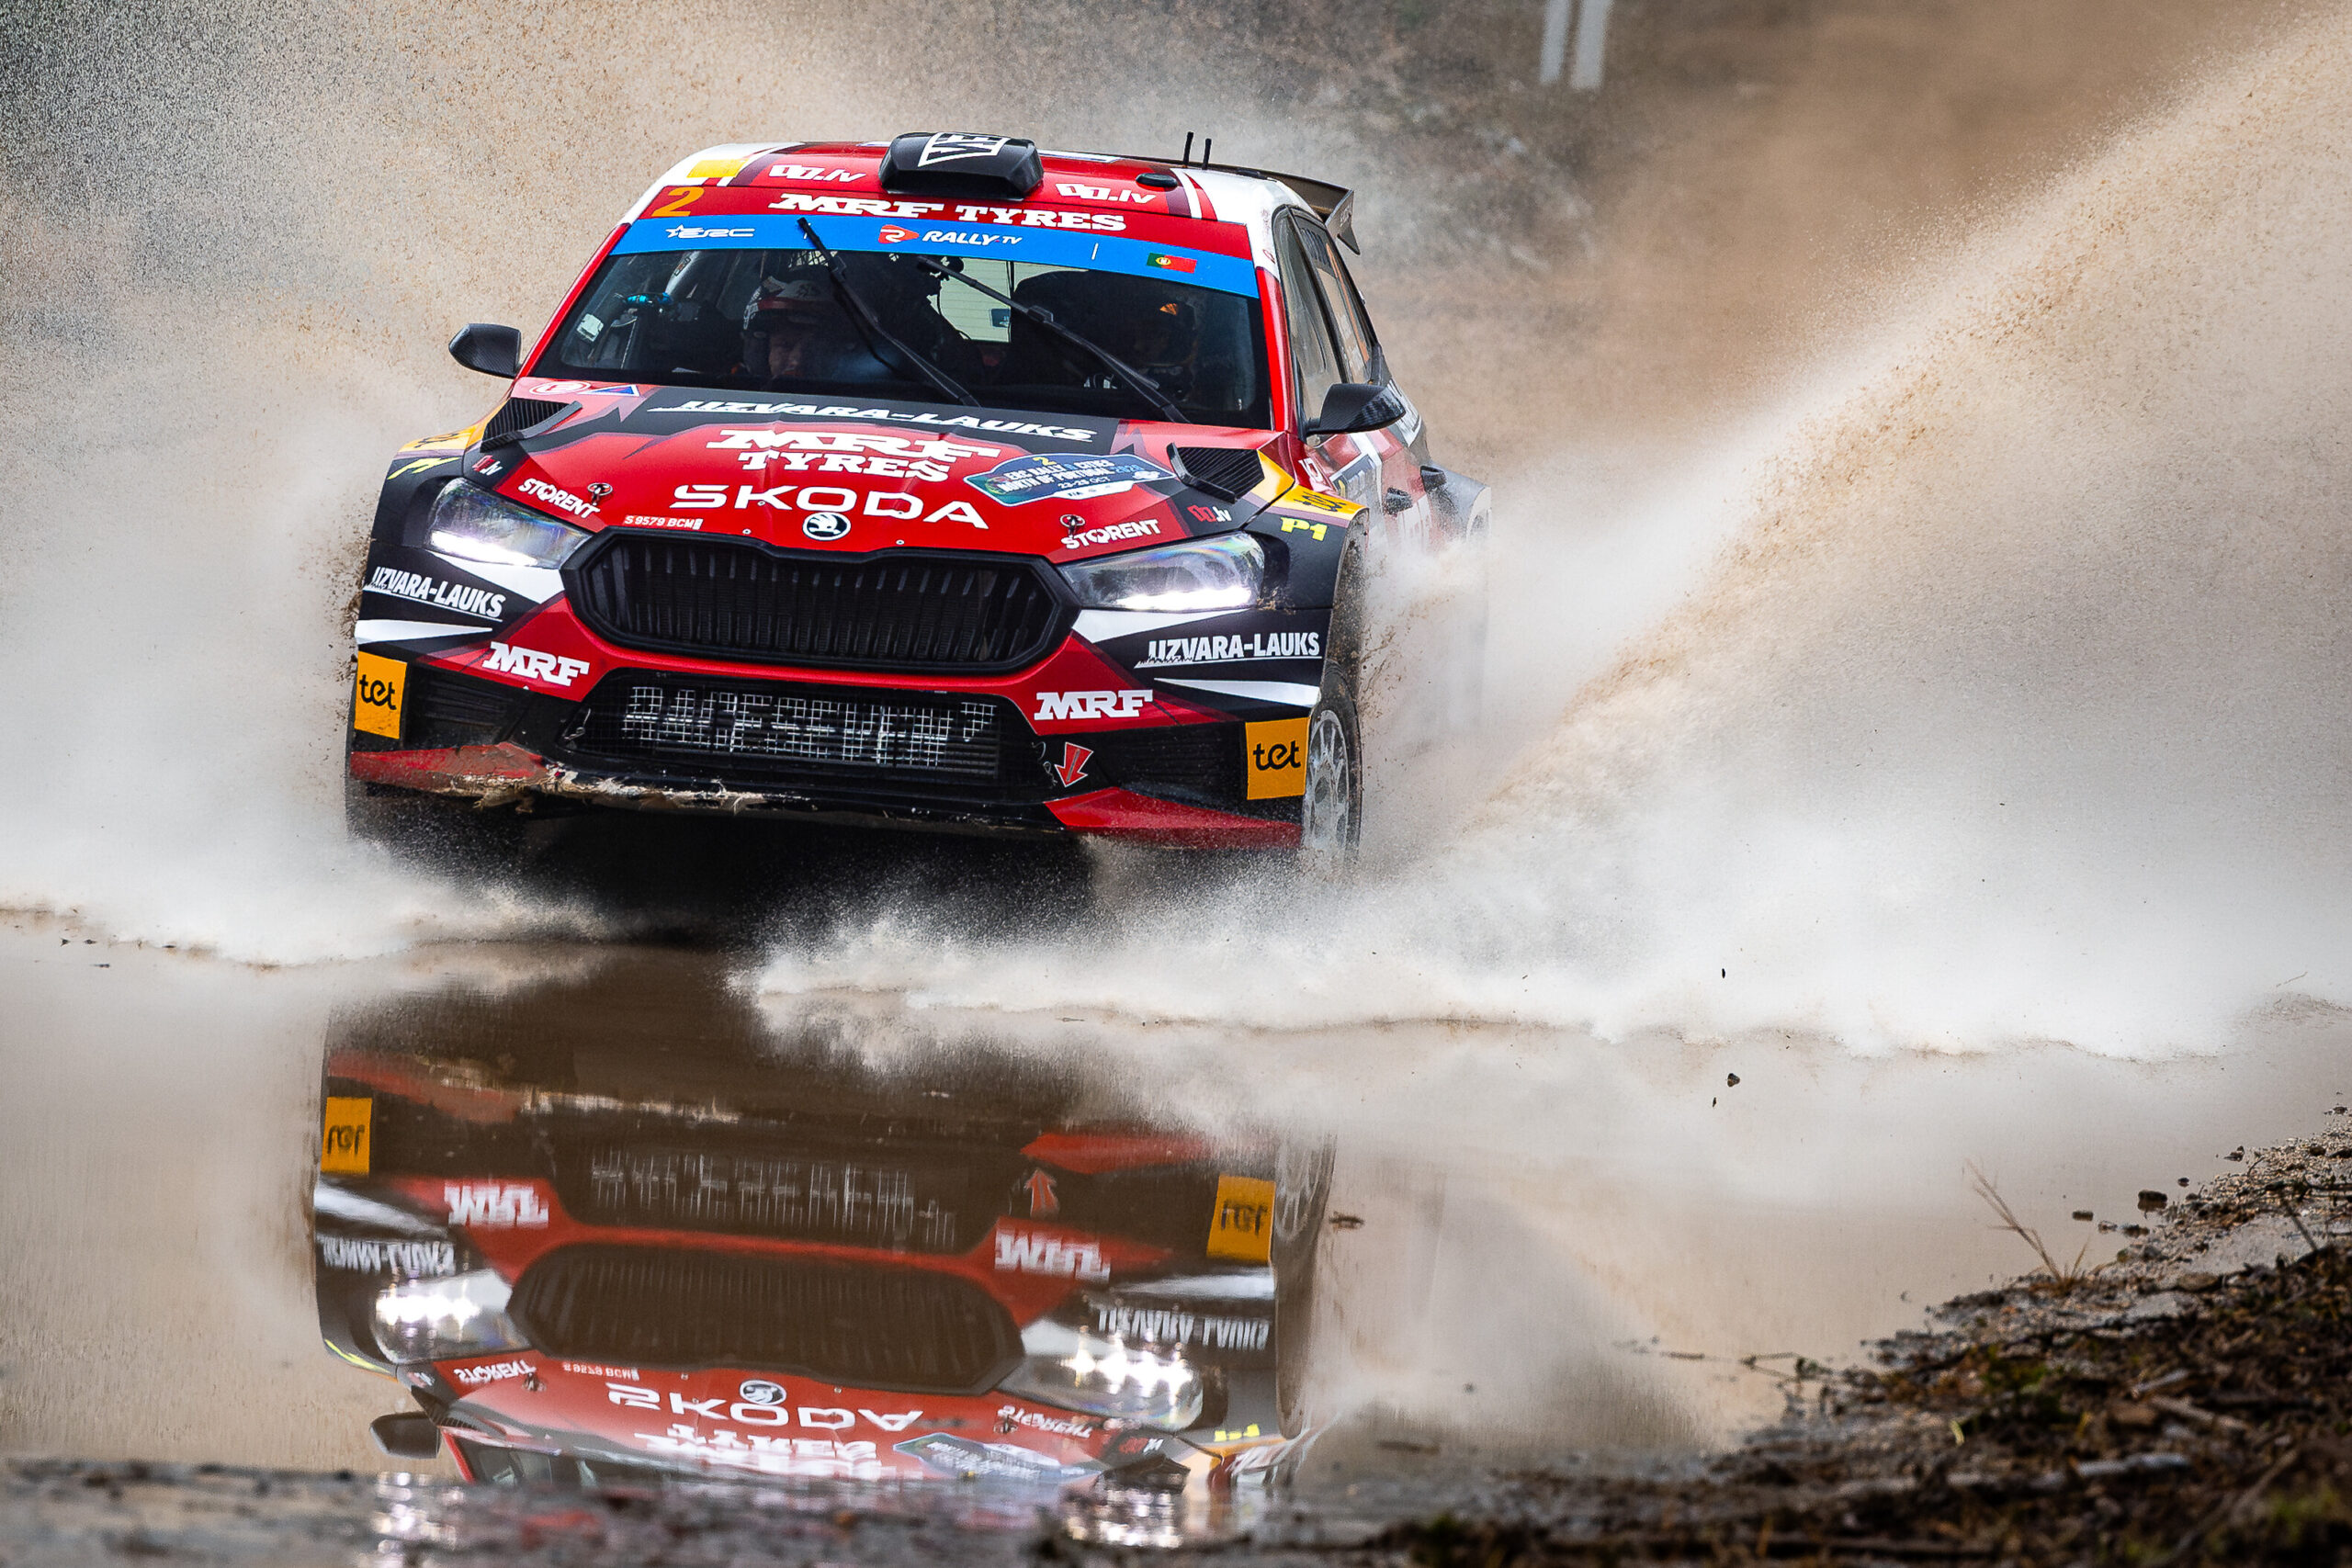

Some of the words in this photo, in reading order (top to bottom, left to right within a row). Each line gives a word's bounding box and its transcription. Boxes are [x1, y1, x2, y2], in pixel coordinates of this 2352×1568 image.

[651, 186, 705, 218] 2
[768, 193, 944, 219] MRF
[956, 204, 1127, 231] TYRES
[922, 230, 1000, 246] RALLY
[706, 429, 1001, 463] MRF
[737, 450, 954, 482] TYRES
[517, 478, 601, 519] STORENT
[624, 514, 635, 525] S
[634, 515, 666, 527] 9579
[666, 517, 695, 529] BCM
[1060, 519, 1163, 549] STORENT
[1280, 516, 1328, 542] P1
[368, 566, 506, 619] UZVARA-LAUKS
[1143, 631, 1321, 663] UZVARA-LAUKS
[481, 641, 591, 687] MRF
[359, 674, 397, 711] tet
[1034, 689, 1153, 721] MRF
[1252, 739, 1302, 771] tet
